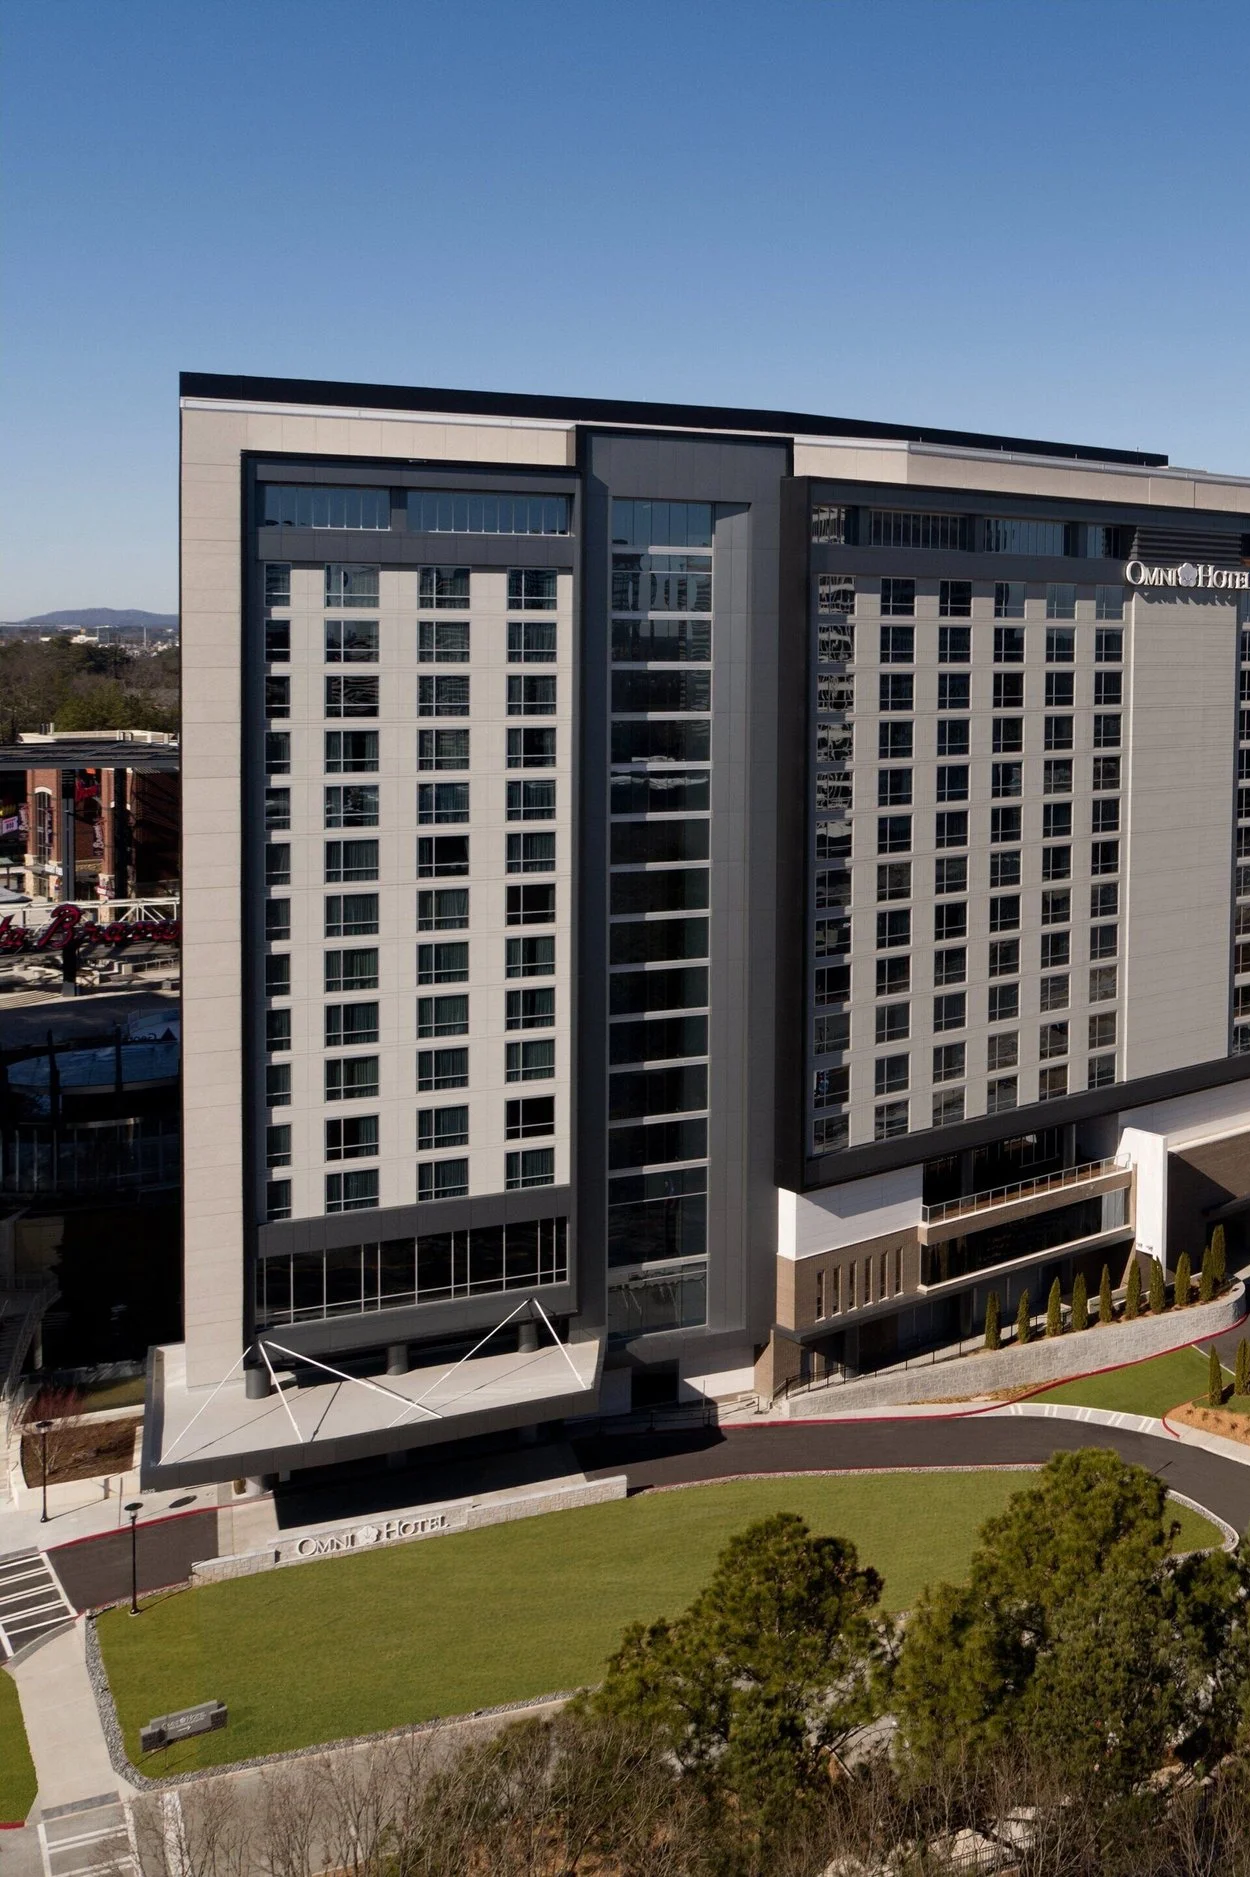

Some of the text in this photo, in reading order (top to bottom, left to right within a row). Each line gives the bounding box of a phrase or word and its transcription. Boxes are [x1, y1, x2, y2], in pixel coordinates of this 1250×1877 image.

[1124, 560, 1177, 587] OMNI
[297, 1515, 449, 1556] OMNI HOTEL
